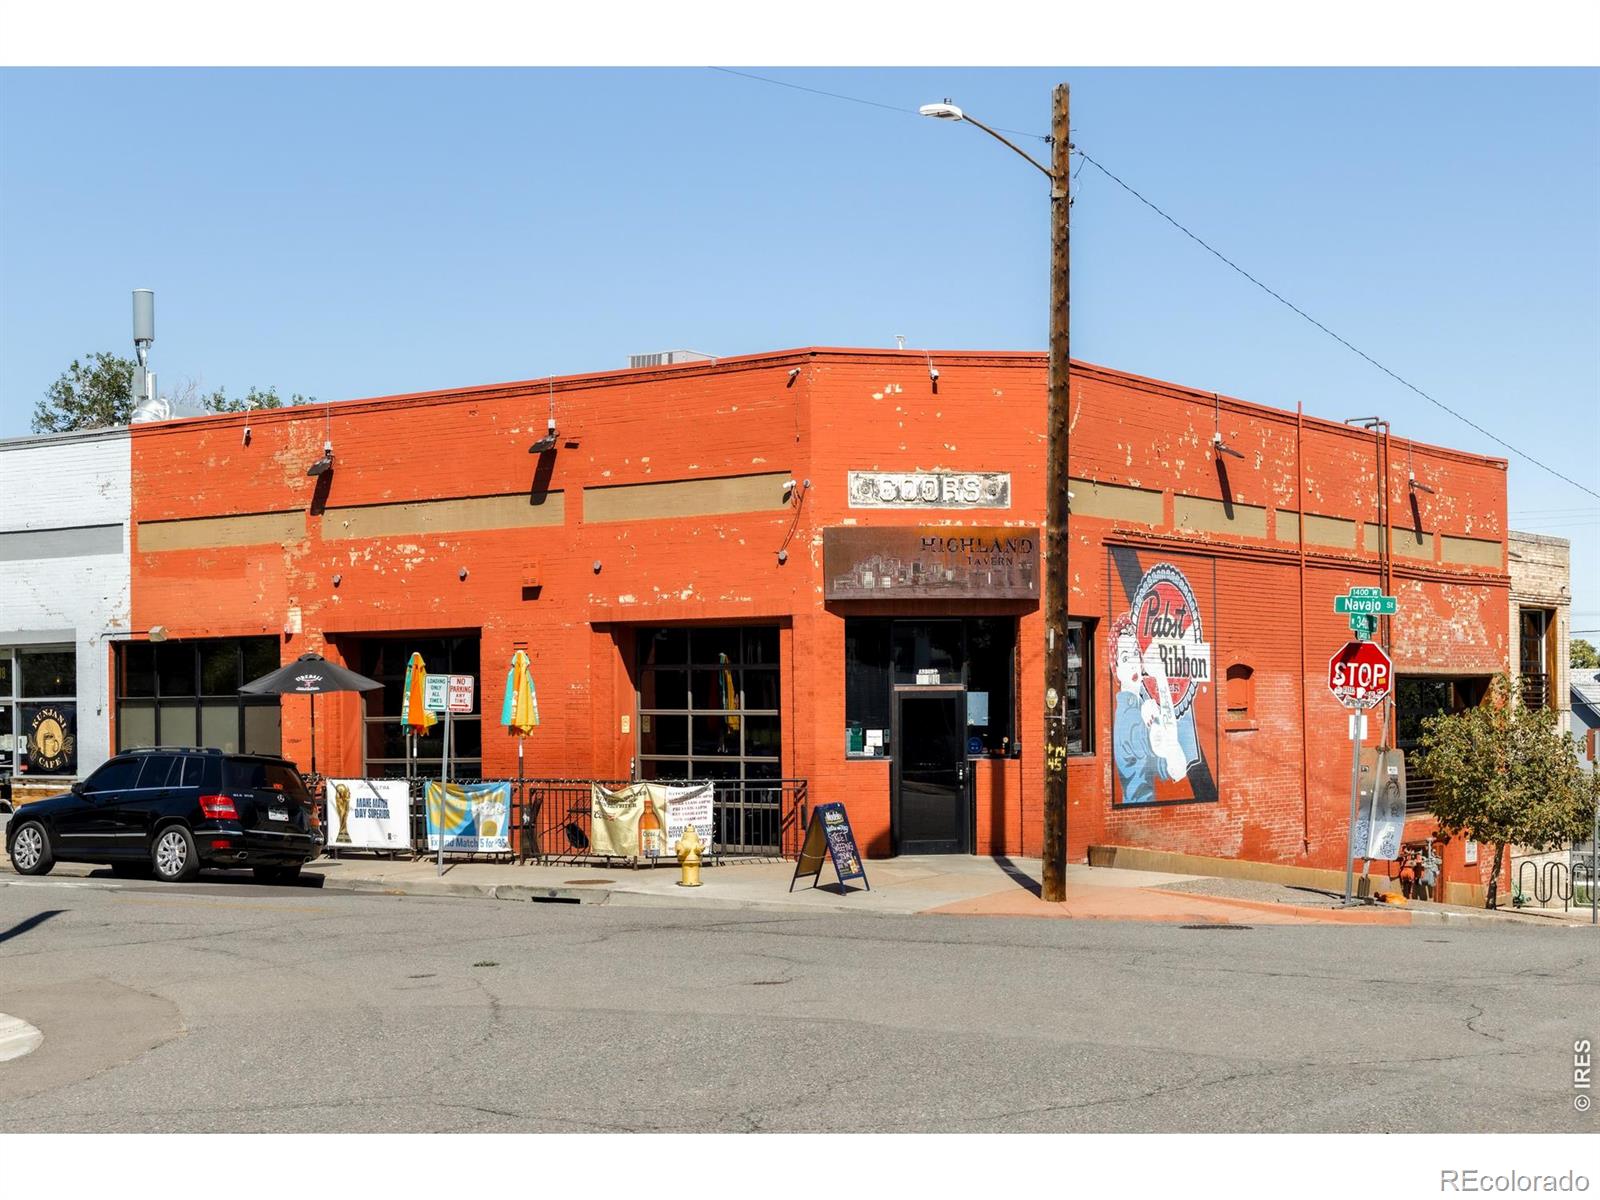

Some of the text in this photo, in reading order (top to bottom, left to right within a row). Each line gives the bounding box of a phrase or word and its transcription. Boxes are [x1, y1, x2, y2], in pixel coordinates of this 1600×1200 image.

[877, 474, 981, 503] COORS
[921, 537, 1033, 554] HIGHLAND
[967, 555, 1014, 567] TAVERN
[1344, 598, 1382, 613] Navajo
[1142, 589, 1188, 640] Pabst
[1158, 643, 1208, 679] Ribbon
[1333, 662, 1387, 688] STOP
[31, 708, 67, 729] KUNJANI
[356, 798, 388, 809] MAKE MATCH
[354, 808, 391, 820] DAY SUPERIOR
[455, 837, 479, 848] Match
[480, 838, 484, 848] 5
